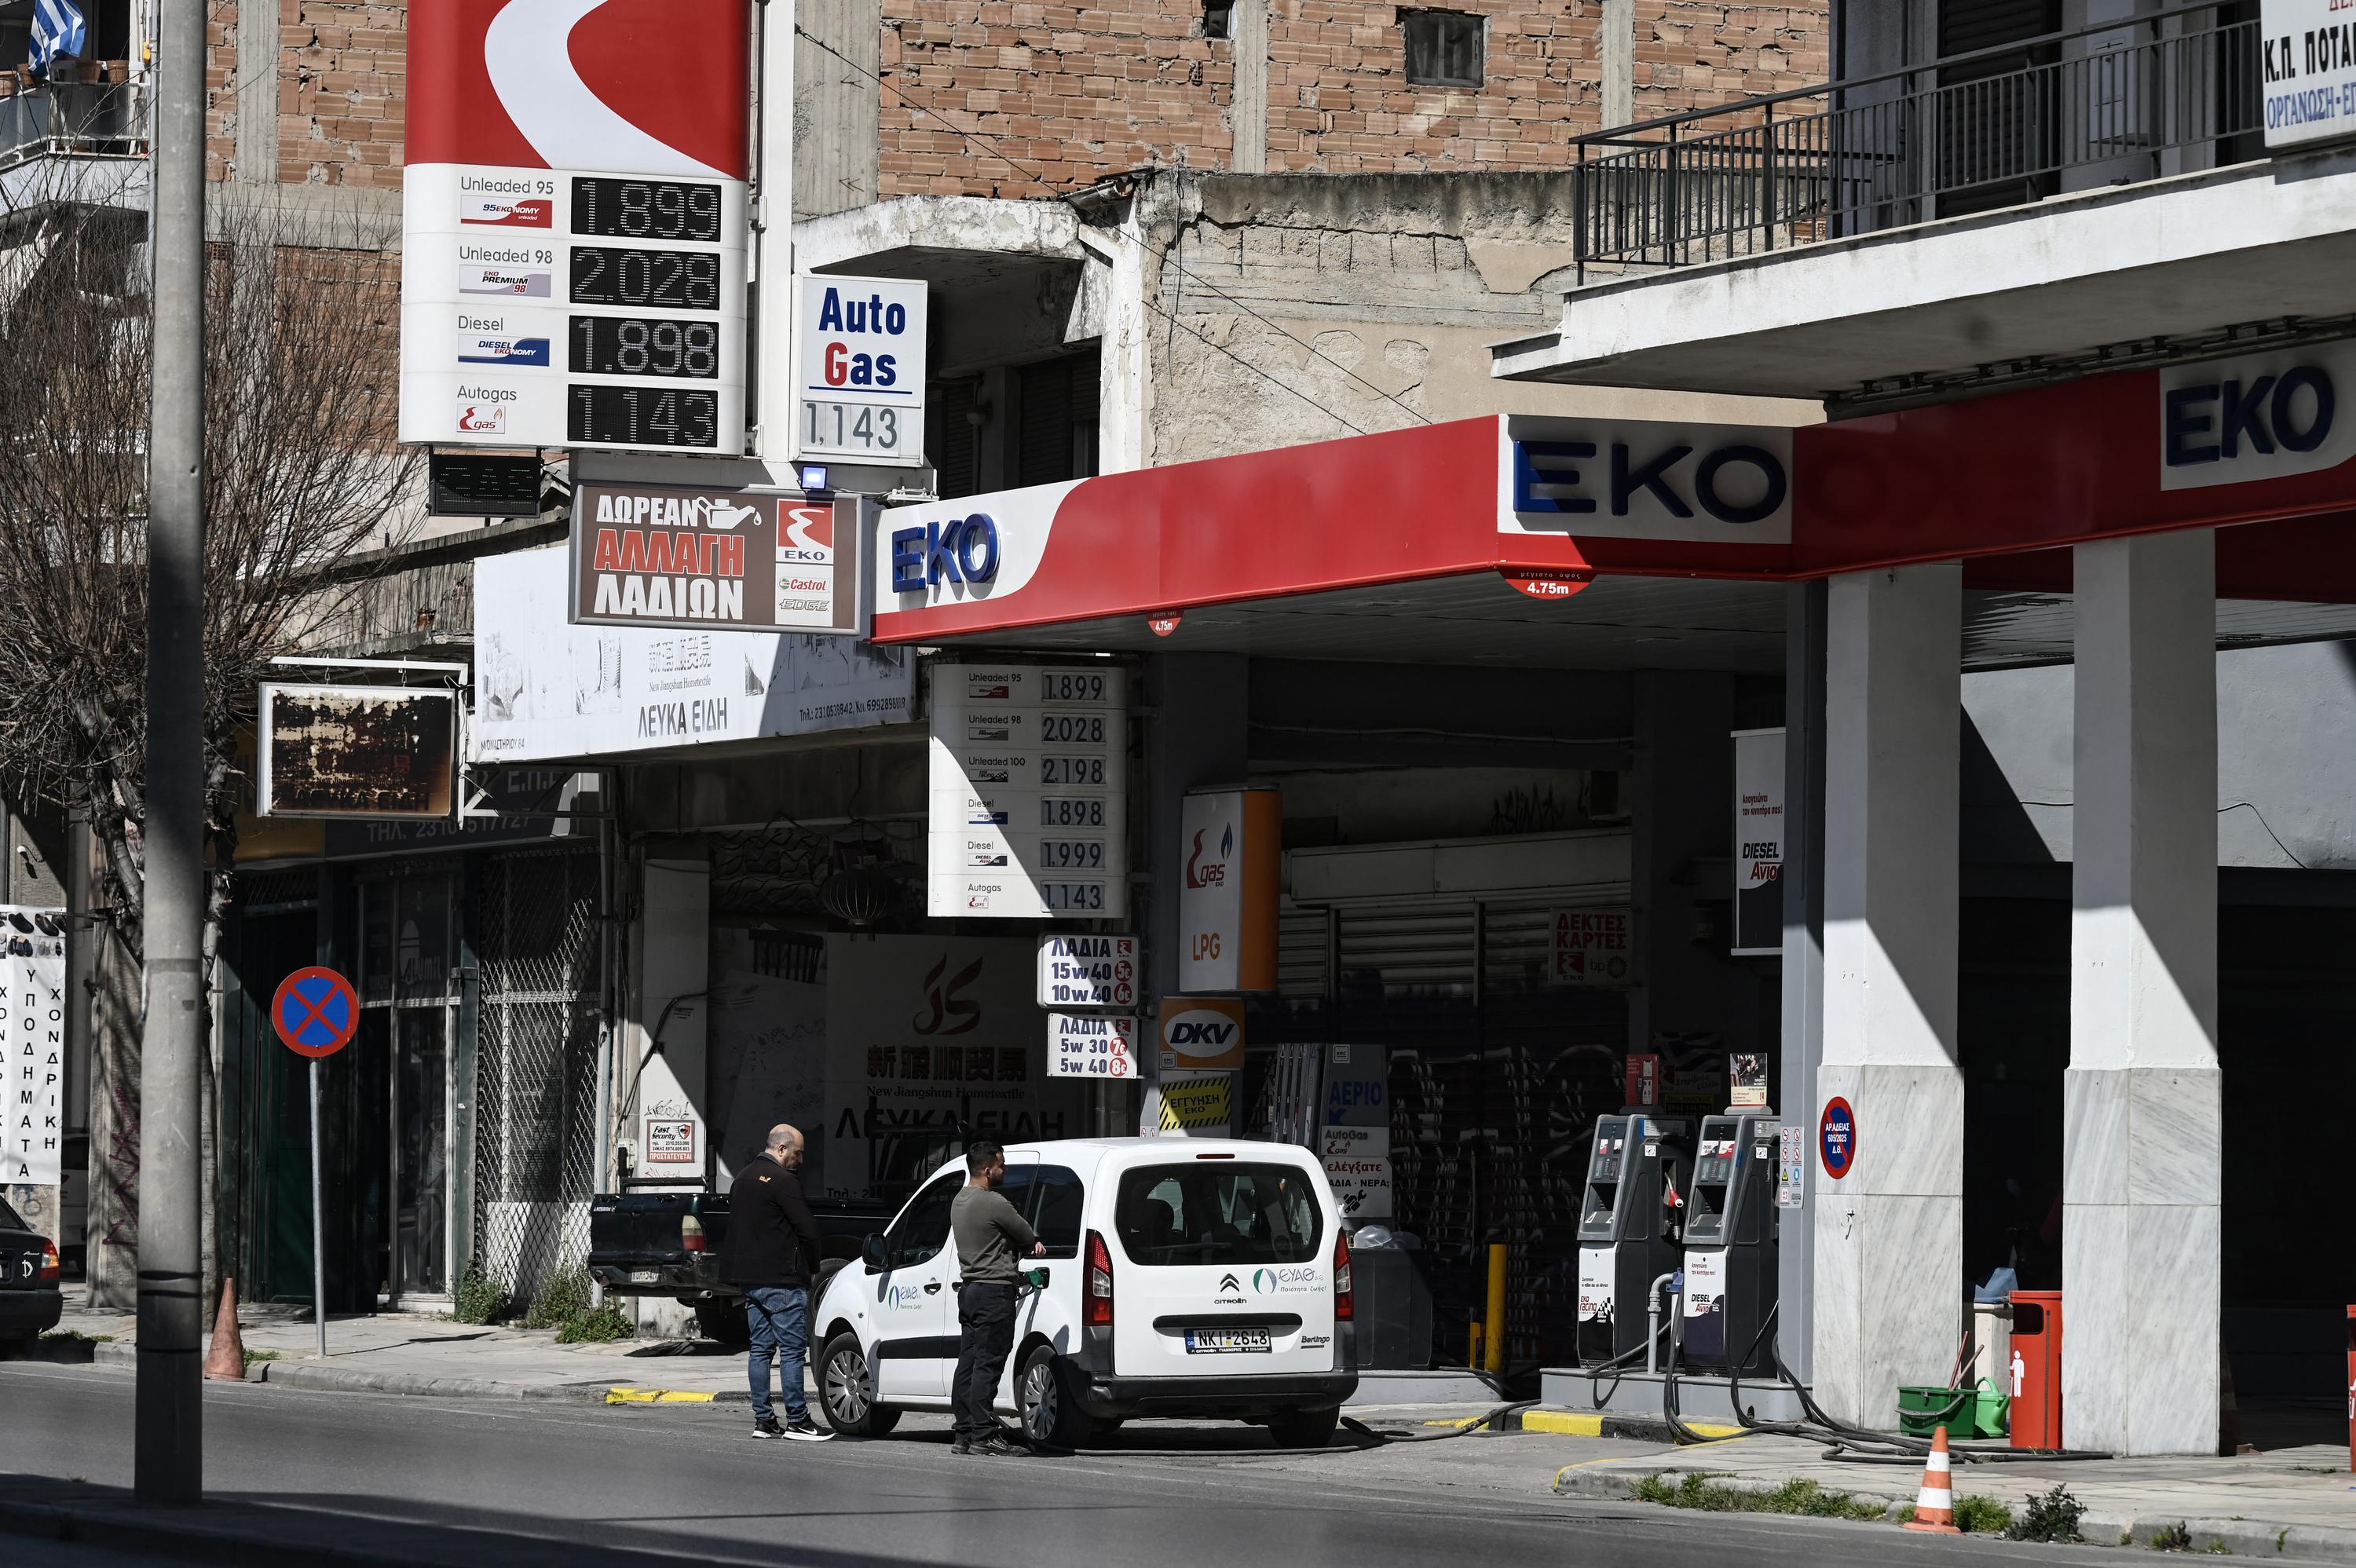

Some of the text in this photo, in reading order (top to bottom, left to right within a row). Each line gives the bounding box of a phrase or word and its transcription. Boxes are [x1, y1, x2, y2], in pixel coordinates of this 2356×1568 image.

[2305, 23, 2356, 75] ΠΟΤΑ
[461, 176, 554, 194] Unleaded 95
[581, 181, 718, 238] 1.899
[459, 246, 553, 264] Unleaded 98
[575, 249, 716, 305] 2.028
[514, 284, 527, 293] 98
[818, 287, 905, 335] Auto
[458, 316, 503, 331] Diesel
[478, 341, 511, 349] DIESEL
[579, 319, 715, 375] 1.898
[825, 342, 897, 386] Gas
[457, 386, 517, 403] Autogas
[578, 389, 714, 444] 1.143
[2166, 366, 2335, 467] EKO
[1513, 440, 1787, 524] EKO
[596, 495, 698, 527] ΔΩΡΕΑΝ
[594, 528, 745, 577] ΑΛΛΑΓΗ
[785, 550, 825, 561] EKO
[892, 513, 1000, 593] EKO
[791, 579, 826, 590] Castrol
[1527, 582, 1569, 594] 4.75m
[594, 573, 743, 620] ΛΑΔΙΩΝ
[779, 599, 829, 612] EDGE
[1155, 620, 1173, 631] 4.75m
[968, 673, 1021, 682] Unleaded 95
[968, 715, 1008, 724] Unleaded
[968, 757, 1008, 766] Unleaded
[968, 799, 994, 808] Diesel
[968, 841, 993, 850] Diesel
[1743, 842, 1779, 859] DIESEL
[968, 883, 1001, 894] Autogas
[1557, 913, 1626, 931] ΔΕΚΤΕΣ
[1052, 938, 1111, 957] ΛΑΔΙΑ
[1193, 933, 1220, 961] LPG
[1557, 932, 1626, 949] ΚΑΡΤΕΣ
[1590, 959, 1605, 974] bp
[1059, 1018, 1107, 1035] ΛΑΔΙΑ
[1169, 1023, 1235, 1044] DKV
[1061, 1038, 1084, 1052] 5w
[1089, 1039, 1108, 1054] 30
[19, 969, 36, 1177] ΥΠΟΔΗΜΑΤΑ
[44, 989, 61, 1150] ΧΟΝΔΡΙΚΗ
[1060, 1058, 1083, 1073] 5w
[1088, 1059, 1107, 1073] 40
[867, 1086, 1025, 1099] New Jiangshun Hometextile
[1329, 1081, 1382, 1106] ΑΕΡΙΟ
[1170, 1094, 1220, 1109] ΕΓΓΥΗΣΗ
[1325, 1130, 1368, 1140] AutoGas
[1327, 1161, 1382, 1172] ελέγξατε
[1361, 1179, 1389, 1188] ΝΕΡΑ;
[1580, 1303, 1597, 1314] racing
